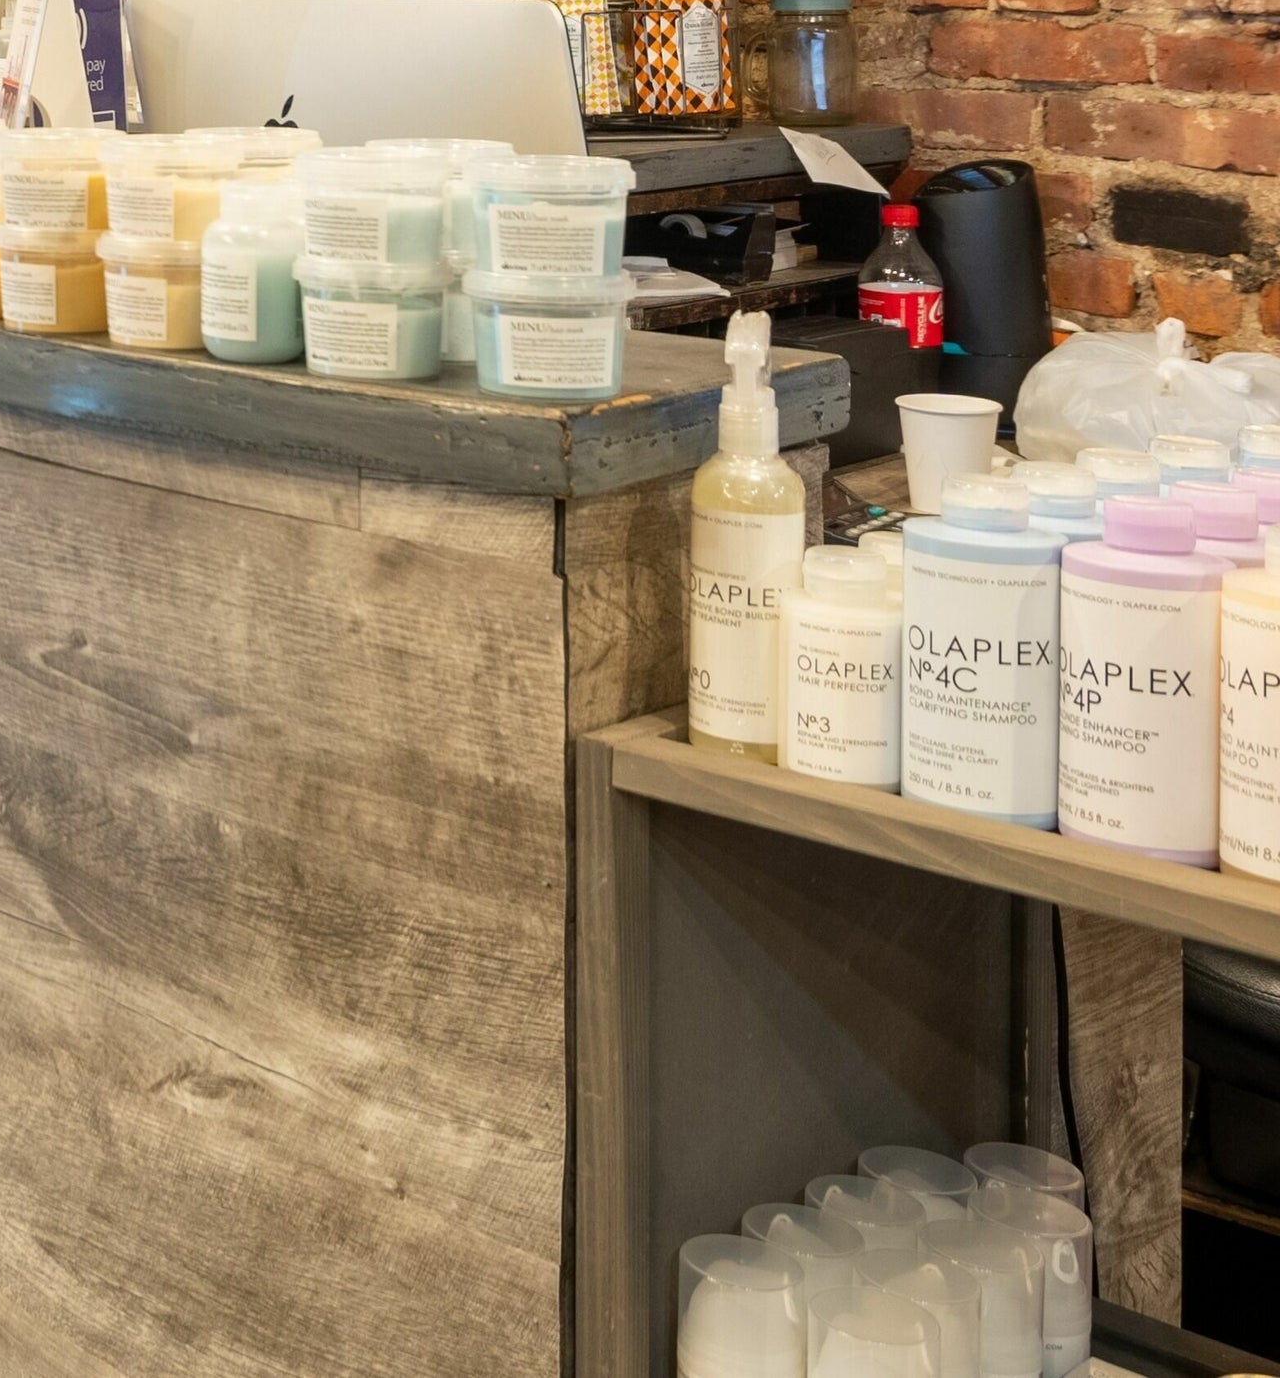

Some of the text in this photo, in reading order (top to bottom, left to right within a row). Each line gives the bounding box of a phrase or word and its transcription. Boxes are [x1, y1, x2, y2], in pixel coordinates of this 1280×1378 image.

[86, 59, 106, 72] pay
[689, 572, 782, 608] OLAPLE
[715, 607, 781, 621] BOND BUILDIN
[908, 624, 1050, 666] OLAPLEX
[797, 654, 894, 681] OLAPLEX
[1060, 646, 1192, 698] OLAPLEX
[1220, 654, 1280, 698] OLAP
[798, 673, 820, 687] HAIR
[909, 683, 934, 699] BOND
[908, 696, 1038, 726] CLARIFYING SHAMPOO
[1082, 732, 1146, 754] SHAMPOO
[933, 760, 953, 772] TYPES
[935, 748, 955, 760] SHINE
[958, 753, 964, 761] &
[966, 755, 999, 766] CLARITY
[945, 782, 962, 795] 8.5
[977, 789, 995, 800] oz.
[1108, 779, 1154, 794] BRIGHTENS
[1241, 788, 1274, 804] ALL HAIR
[1080, 808, 1094, 822] 8.5
